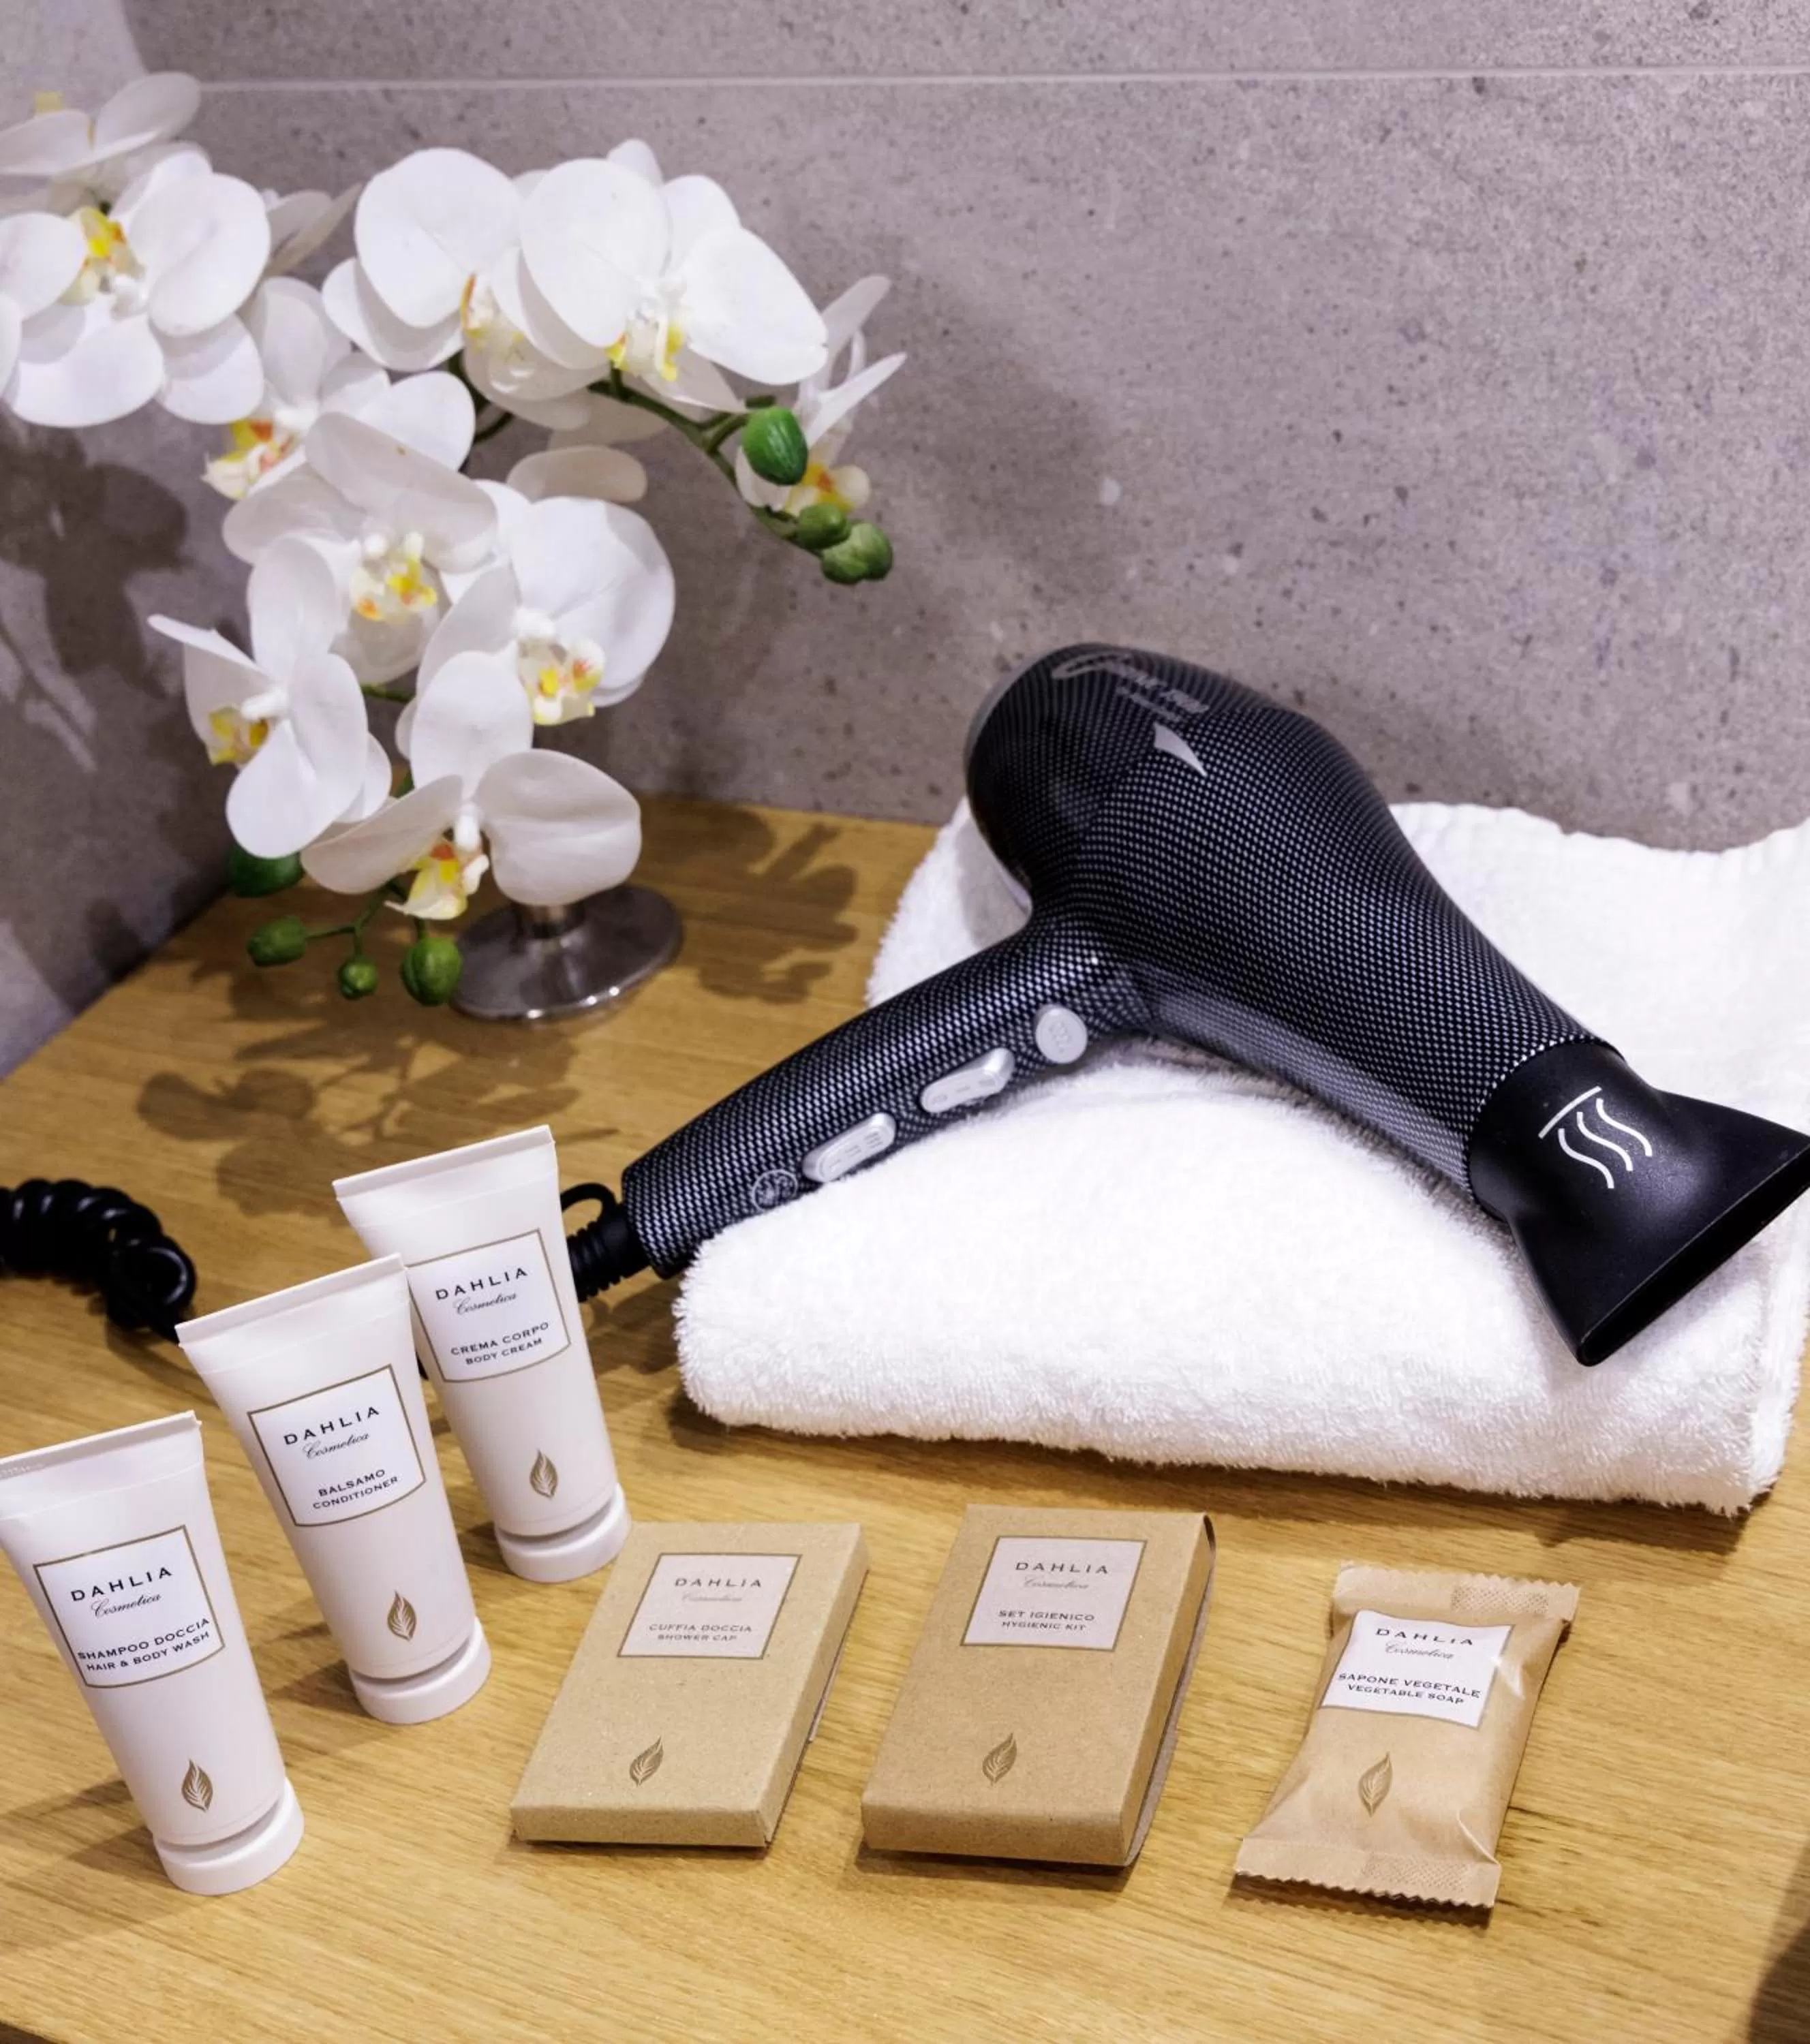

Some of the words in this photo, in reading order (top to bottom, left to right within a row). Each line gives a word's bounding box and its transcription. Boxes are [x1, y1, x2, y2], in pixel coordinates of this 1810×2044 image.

[435, 1267, 528, 1300] DAHLIA
[450, 1336, 498, 1355] CREMA
[502, 1322, 549, 1343] CORPO
[465, 1353, 497, 1365] BODY
[501, 1337, 542, 1357] CREAM
[283, 1406, 380, 1445] DAHLIA
[312, 1476, 398, 1510] CONDITIONER
[318, 1469, 386, 1498] BALSAMO
[1015, 1562, 1108, 1575] DAHLIA
[71, 1567, 172, 1601] DAHLIA
[675, 1577, 762, 1588] DAHLIA
[91, 1593, 161, 1619] Cosmetica
[998, 1609, 1026, 1618] SET
[1029, 1611, 1095, 1622] IGIENICO
[649, 1624, 696, 1632] CUFFIA
[701, 1624, 752, 1633] DOCCIA
[1002, 1621, 1061, 1630] HYGIENIC
[1376, 1628, 1474, 1646] DAHLIA
[77, 1640, 150, 1661] SHAMPOO
[155, 1618, 210, 1645] DOCCIA
[87, 1662, 116, 1672] HAIR
[120, 1659, 129, 1668] &
[134, 1649, 168, 1664] BODY
[172, 1632, 210, 1652] WASH
[1338, 1673, 1399, 1685] SAPONE
[1404, 1679, 1482, 1699] VEGETALE
[1347, 1684, 1424, 1699] VEGETABLE
[1428, 1693, 1465, 1705] SOAP
